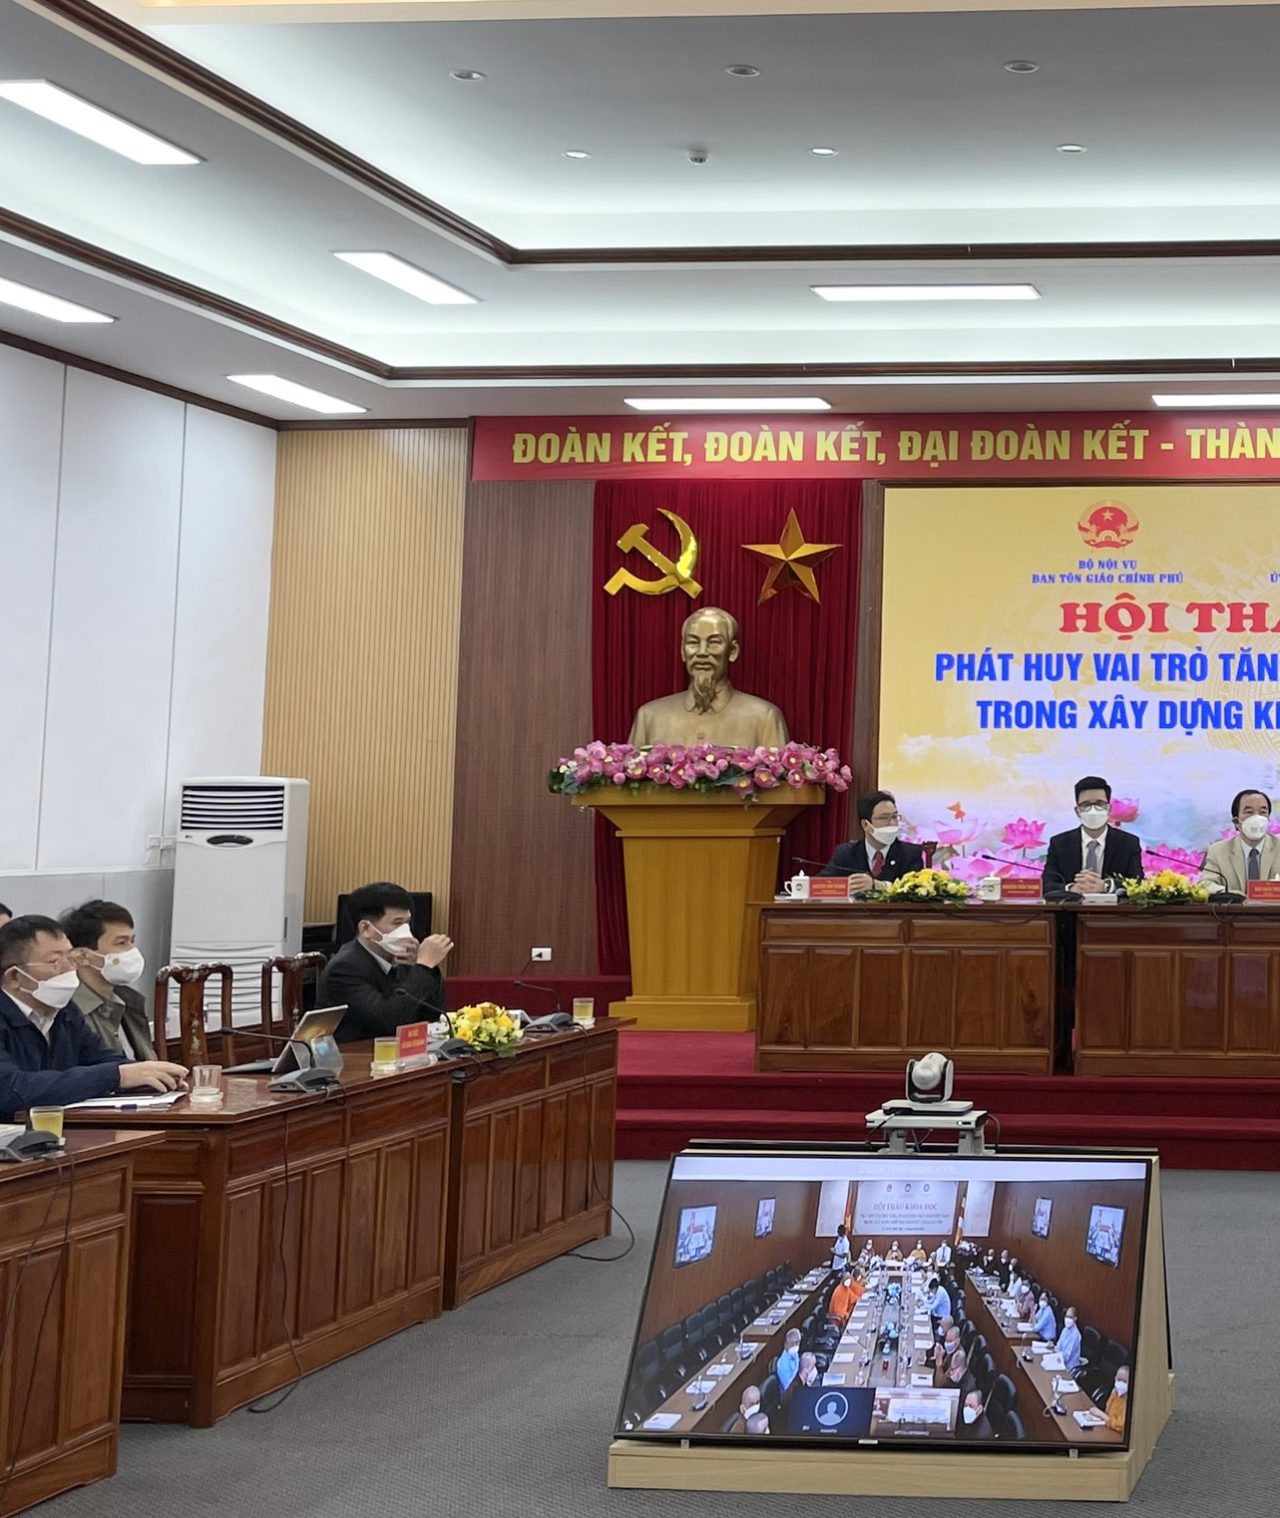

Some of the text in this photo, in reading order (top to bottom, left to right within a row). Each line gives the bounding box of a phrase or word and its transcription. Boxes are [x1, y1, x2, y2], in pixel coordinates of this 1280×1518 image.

[512, 425, 611, 463] ĐOÀN
[622, 422, 692, 466] KẾT,
[704, 423, 804, 462] ĐOÀN
[815, 421, 886, 465] KẾT,
[898, 431, 957, 469] ĐẠI
[971, 421, 1070, 460] ĐOÀN
[1083, 419, 1148, 460] KẾT
[1031, 572, 1183, 584] BAN TÔN GIÁO CHÍNH PHỦ
[1077, 558, 1138, 571] BỘ NỘI VỤ
[1059, 592, 1169, 641] HỘI
[935, 646, 1014, 683] PHÁT
[1023, 653, 1083, 683] HUY
[1093, 653, 1141, 683] VAI
[1150, 646, 1209, 683] TRÒ
[975, 699, 1078, 730] TRONG
[1087, 693, 1150, 730] XÂY
[1157, 698, 1244, 737] DỰNG
